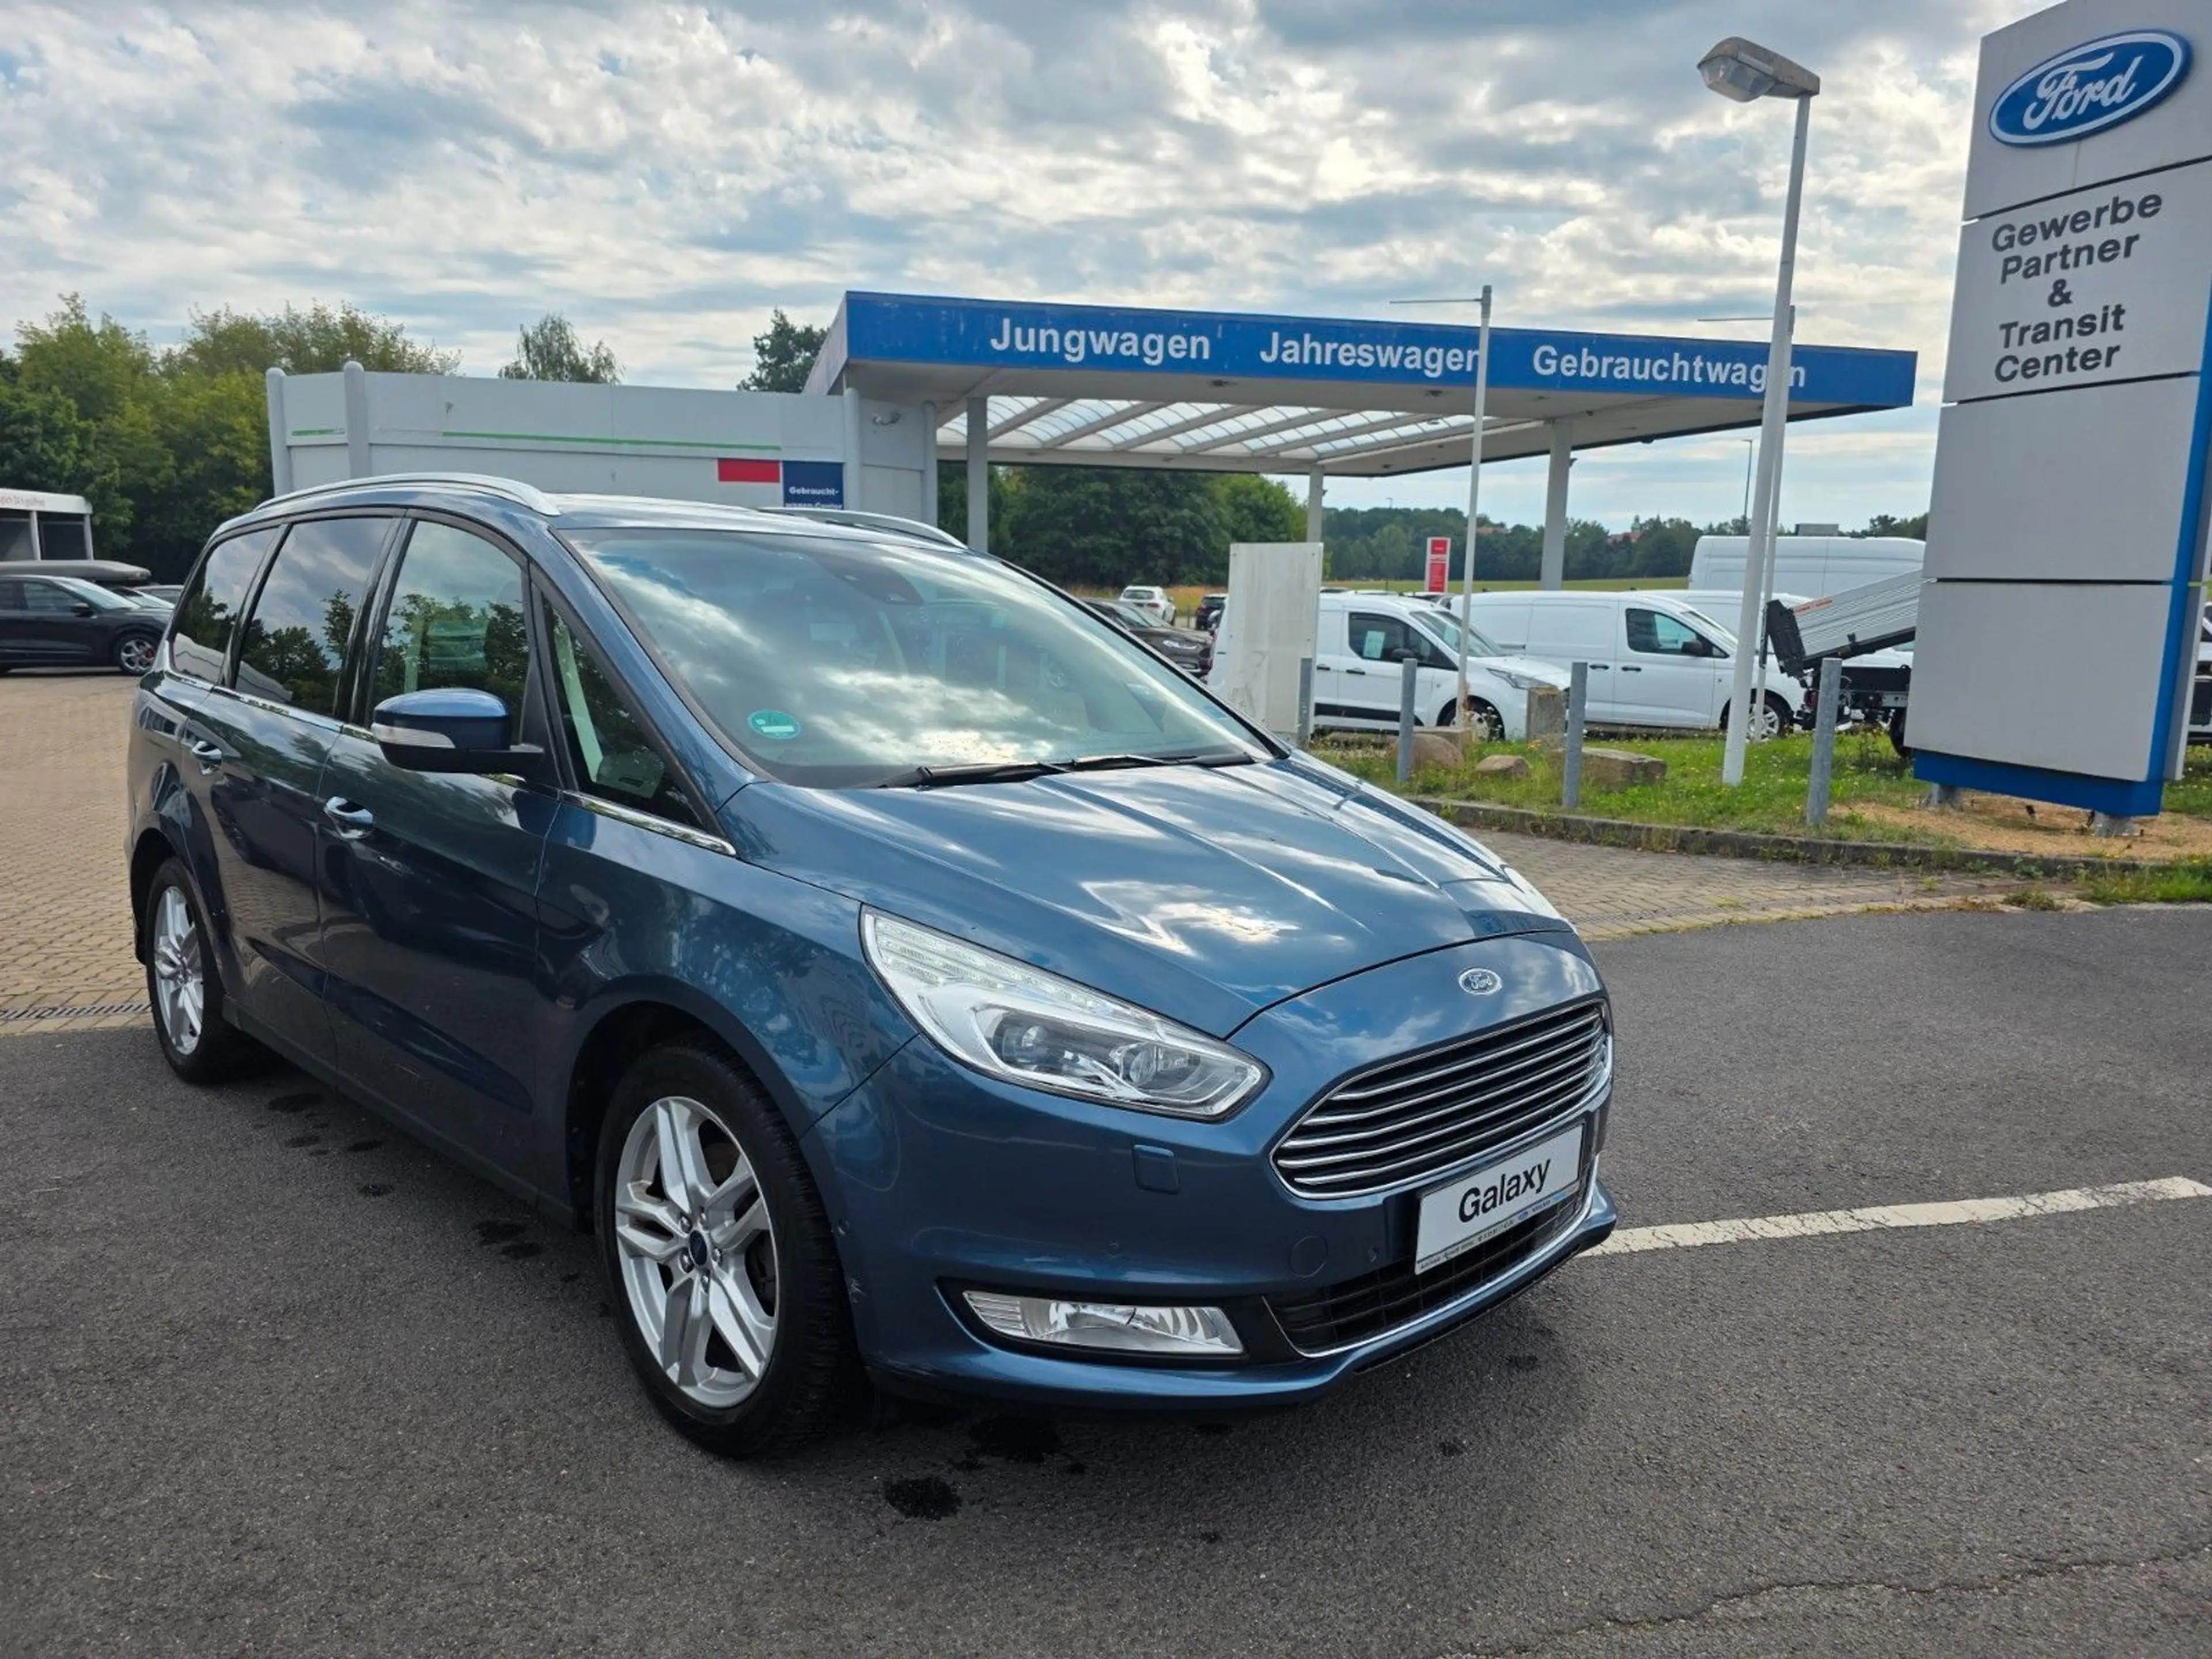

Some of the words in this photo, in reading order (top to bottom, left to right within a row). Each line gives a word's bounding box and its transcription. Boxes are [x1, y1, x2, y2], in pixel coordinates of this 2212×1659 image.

[2022, 51, 2143, 130] Ford
[1991, 194, 2162, 252] Gewerbe
[2001, 233, 2140, 284] Partner
[2047, 278, 2073, 308] &
[1999, 304, 2126, 349] Transit
[990, 317, 1210, 366] Jungwagen
[1533, 344, 1805, 393] Gebrauchtwagn
[1995, 345, 2121, 383] Center
[1458, 1158, 1552, 1224] Galaxy
